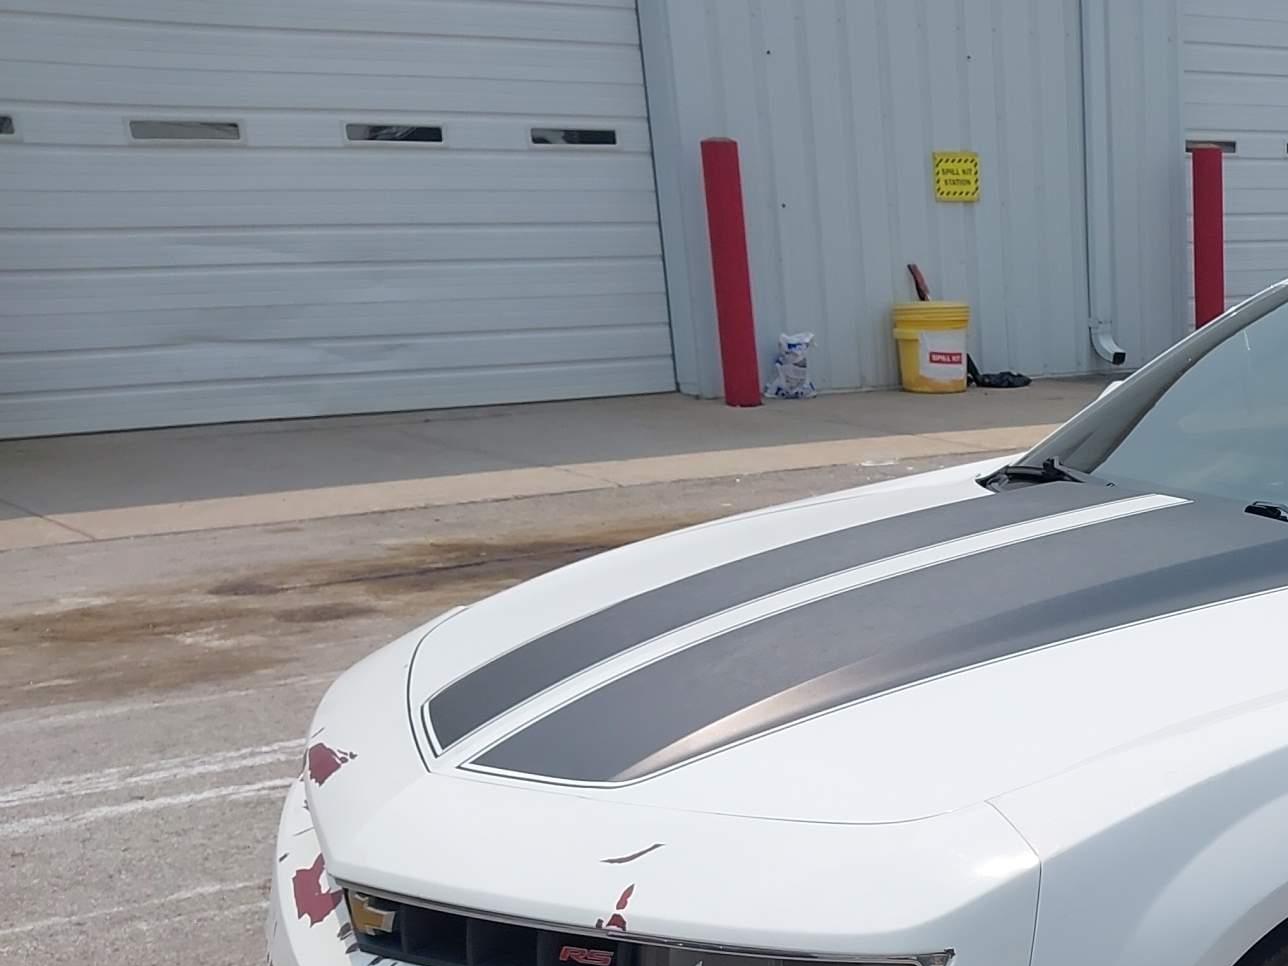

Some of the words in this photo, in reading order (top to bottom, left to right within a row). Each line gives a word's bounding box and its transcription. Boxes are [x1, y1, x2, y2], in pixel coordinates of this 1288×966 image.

[941, 168, 960, 176] SPILL
[962, 168, 973, 176] KIT
[559, 945, 614, 966] RS
